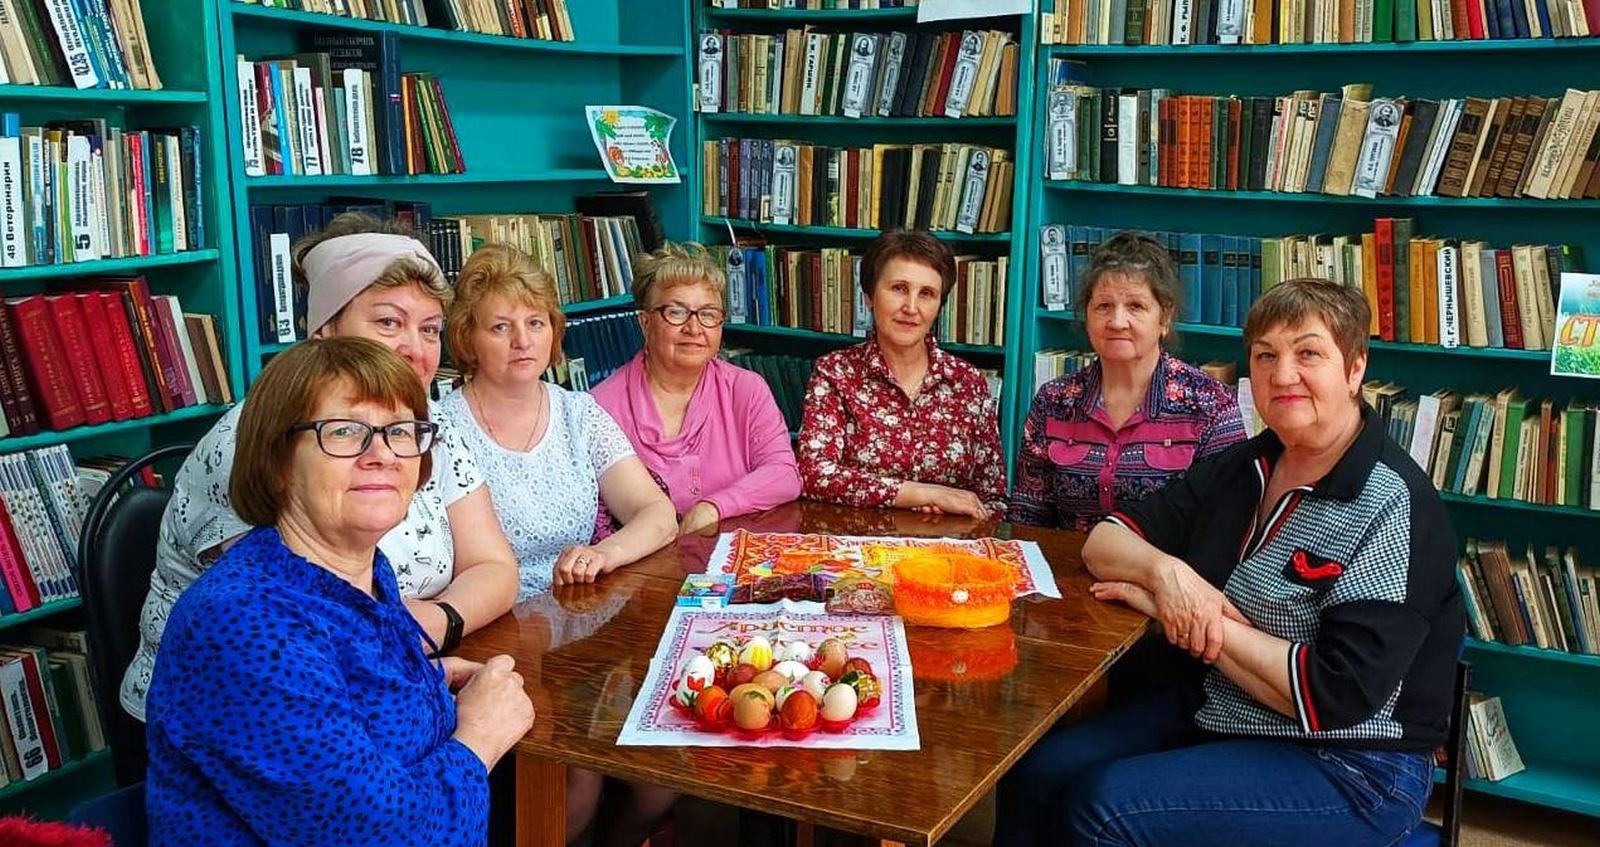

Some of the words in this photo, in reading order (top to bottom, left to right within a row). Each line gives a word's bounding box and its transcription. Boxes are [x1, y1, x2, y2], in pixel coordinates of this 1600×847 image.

[350, 146, 364, 164] 78
[4, 161, 14, 240] Ветеринария
[74, 233, 90, 250] 5
